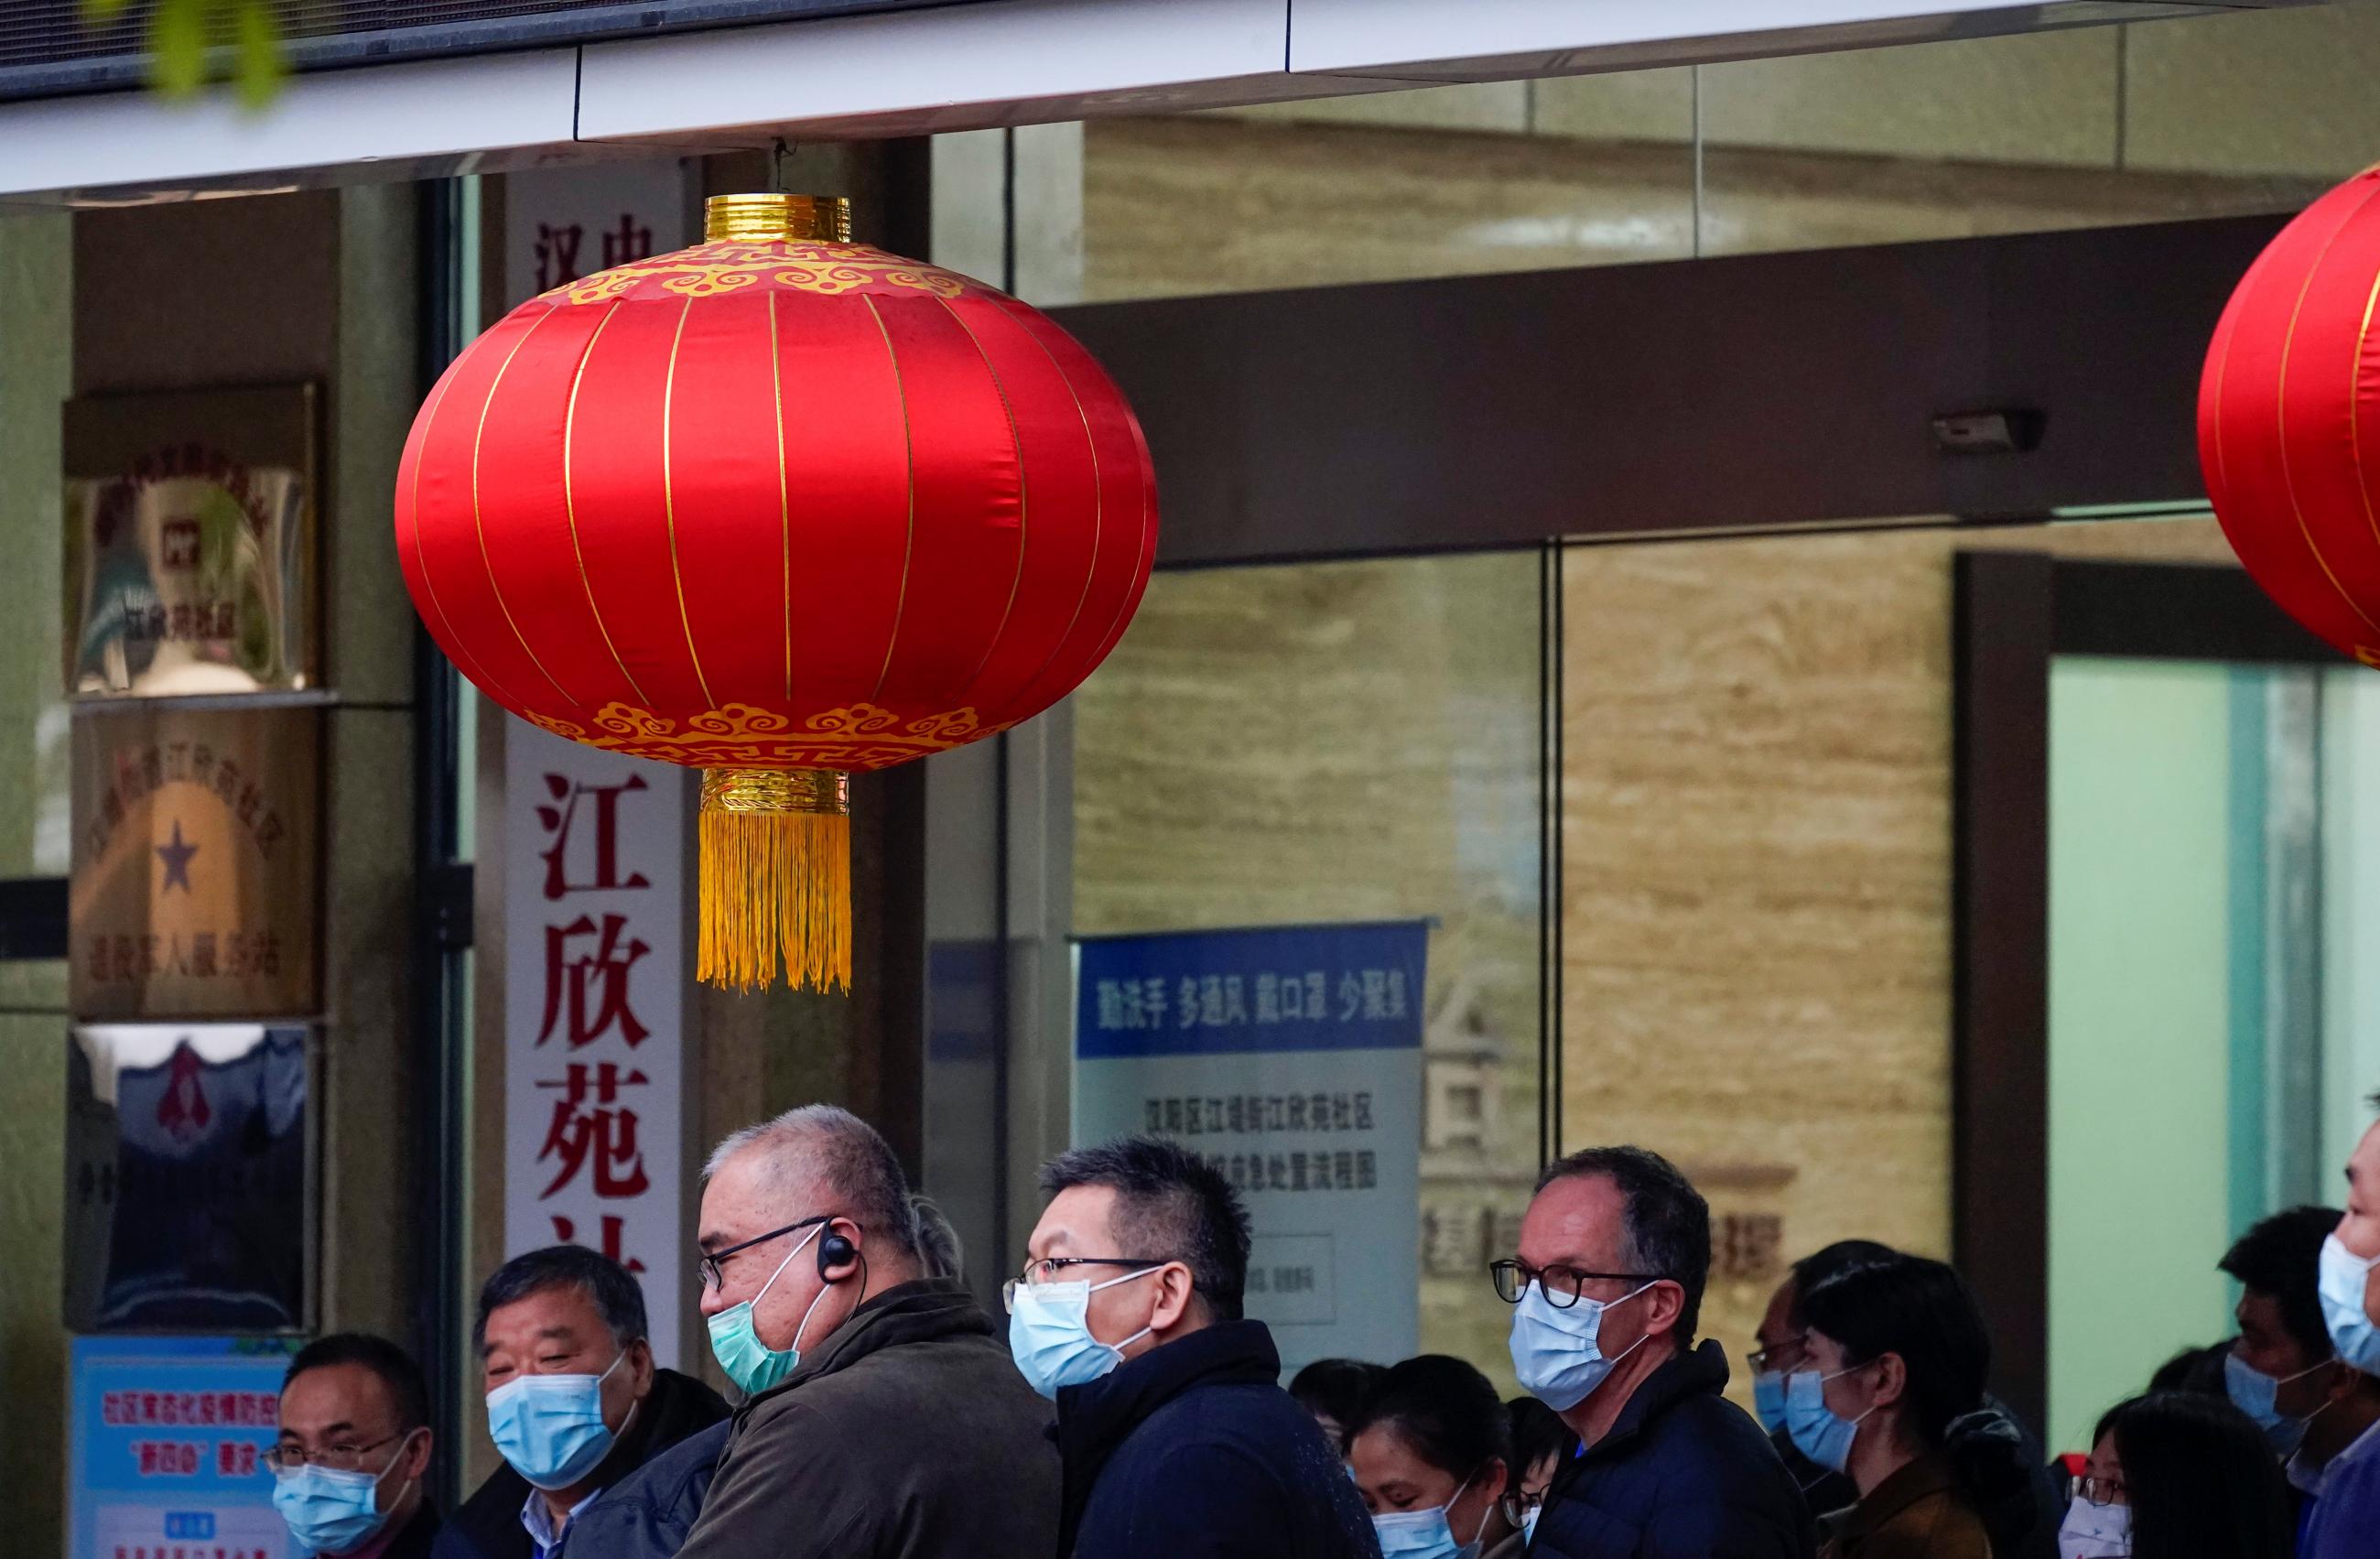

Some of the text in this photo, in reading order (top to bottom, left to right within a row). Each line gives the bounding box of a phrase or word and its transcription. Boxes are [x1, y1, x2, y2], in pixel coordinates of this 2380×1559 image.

[1098, 968, 1407, 1030] 勤洗手 多通风 戴口罩 少聚集
[218, 1441, 257, 1477] 要求
